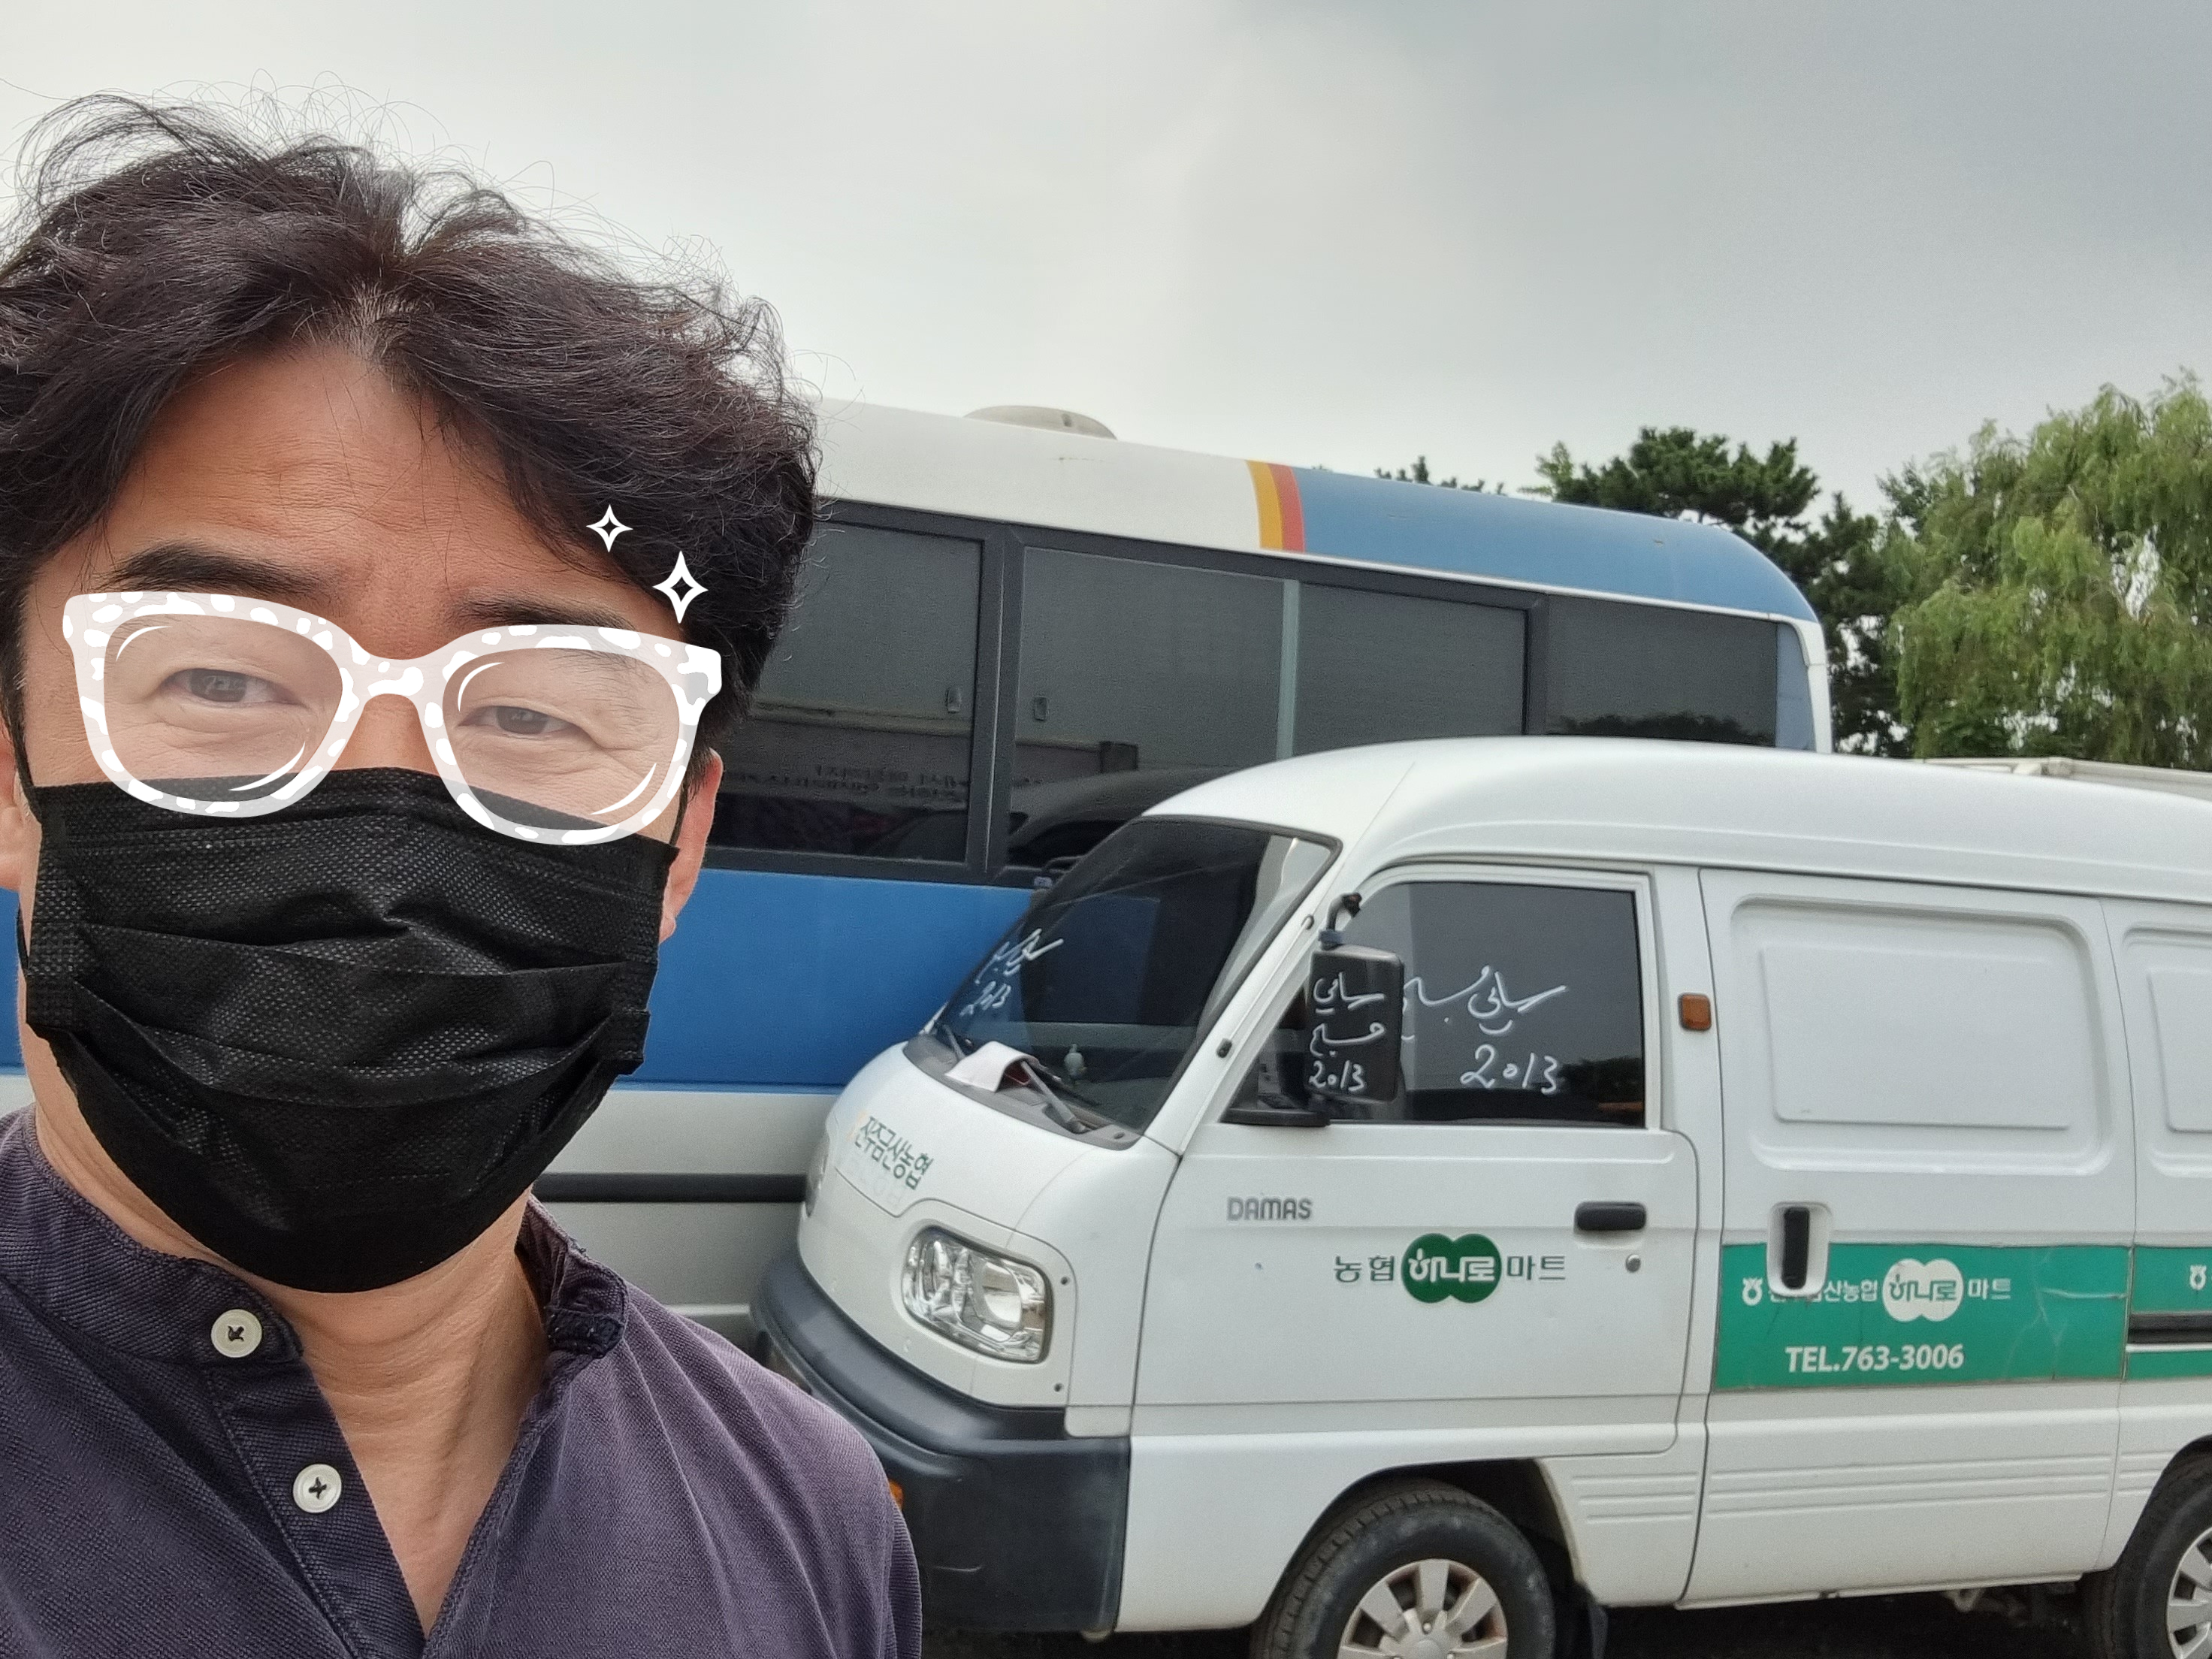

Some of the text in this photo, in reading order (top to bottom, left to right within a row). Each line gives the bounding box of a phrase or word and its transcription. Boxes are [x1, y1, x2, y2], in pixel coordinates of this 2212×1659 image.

[1309, 1060, 1366, 1092] 2013
[1461, 1044, 1561, 1096] 2013
[855, 1116, 934, 1190] 진주금산농협
[1226, 1197, 1313, 1221] DAMAS
[1408, 1248, 1495, 1283] 하나로
[1506, 1255, 1565, 1280] 마트
[1968, 1277, 2012, 1301] 마트
[1785, 1345, 1963, 1373] TEL.763-3006
